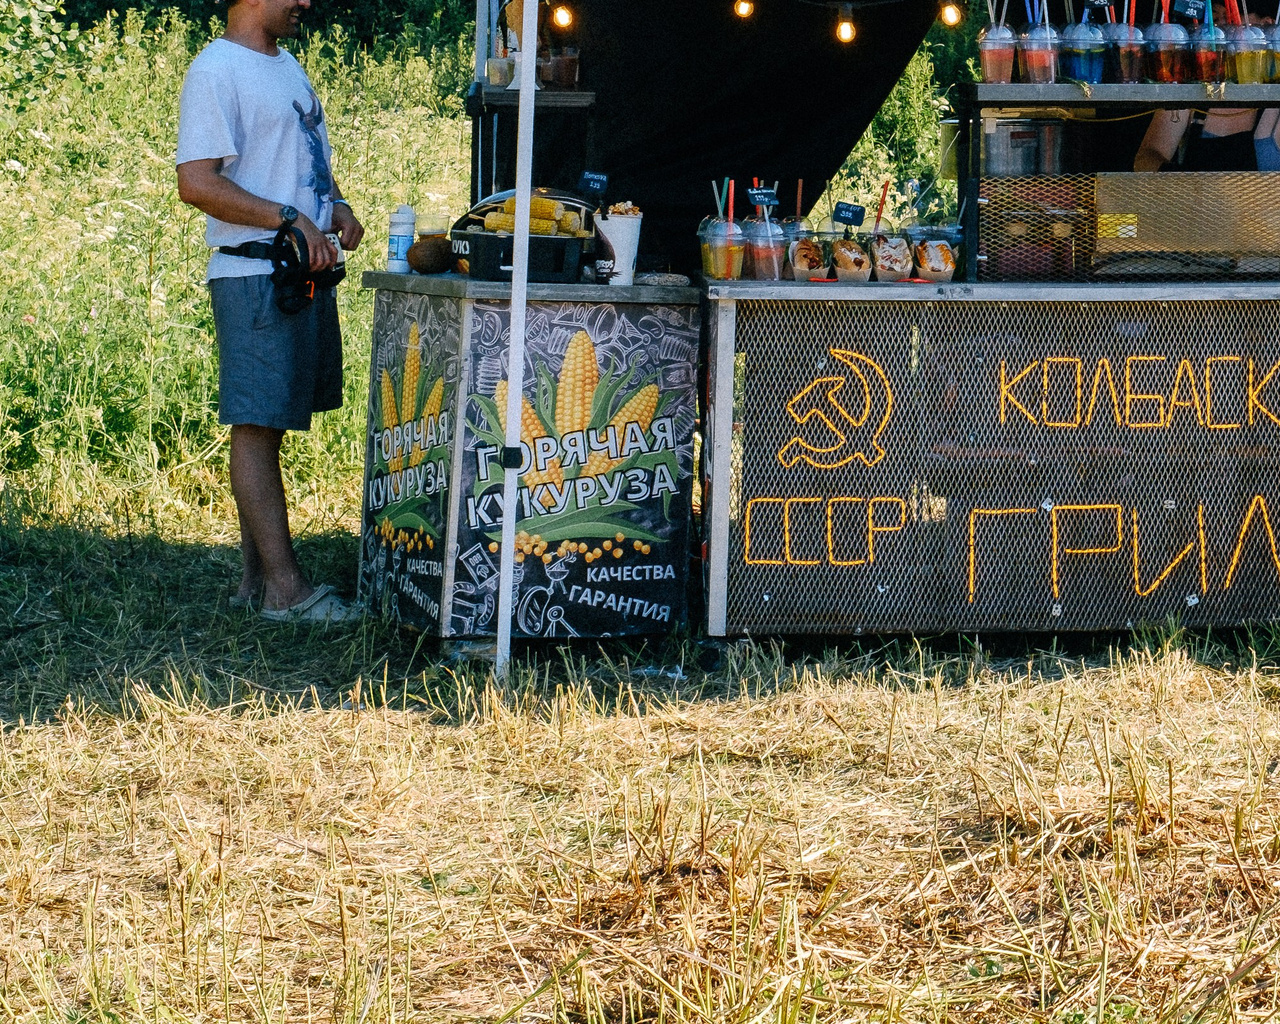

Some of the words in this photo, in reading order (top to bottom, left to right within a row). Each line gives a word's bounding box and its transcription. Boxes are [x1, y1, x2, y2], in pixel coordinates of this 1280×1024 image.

[373, 409, 450, 465] ГОРЯЧАЯ
[368, 457, 449, 511] КУКУРУЗА
[744, 496, 907, 566] СССР
[406, 557, 443, 577] КАЧЕСТВА
[585, 564, 676, 582] КАЧЕСТВА
[400, 574, 440, 621] ГАРАНТИЯ
[566, 584, 672, 623] ГАРАНТИЯ
